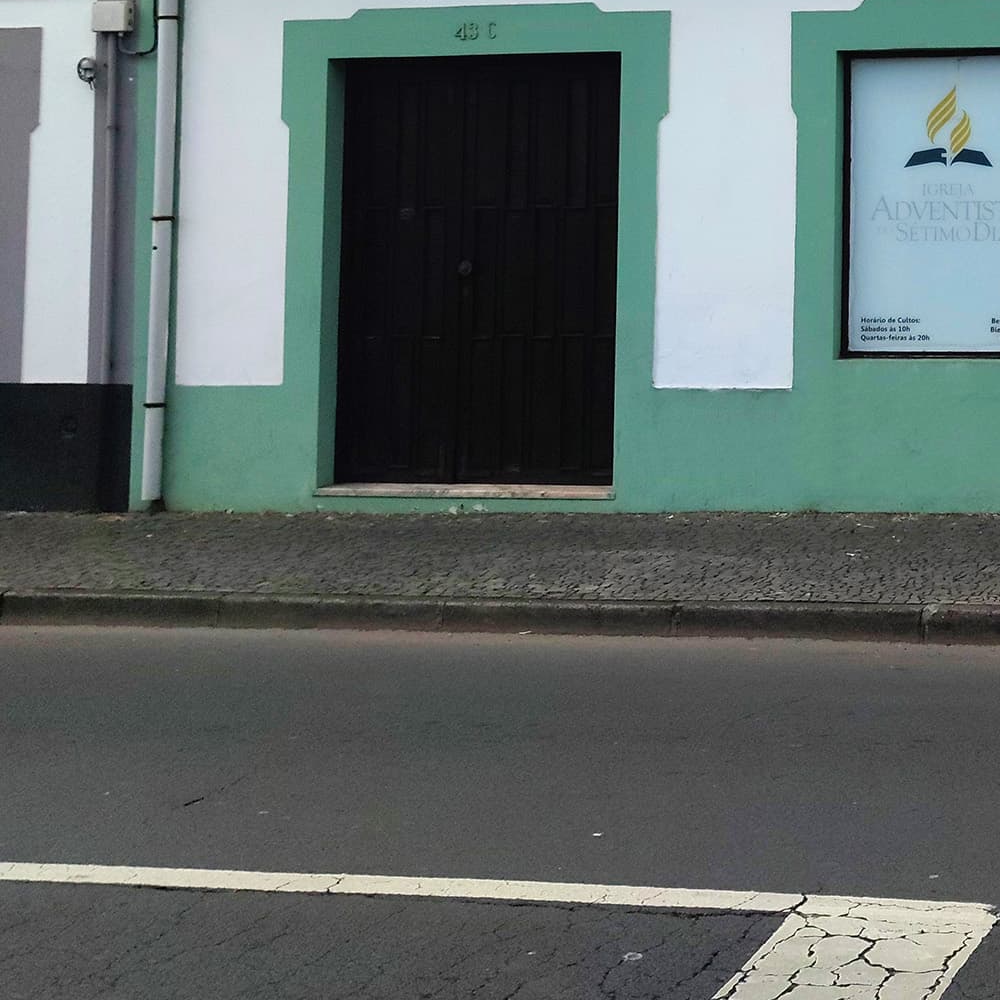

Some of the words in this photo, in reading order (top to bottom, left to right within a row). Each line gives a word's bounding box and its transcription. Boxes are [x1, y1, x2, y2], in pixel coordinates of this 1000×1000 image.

[455, 22, 480, 41] 43
[860, 325, 888, 333] Sábados
[898, 325, 911, 333] 10h
[860, 334, 907, 342] Quartas-feiras
[917, 334, 930, 342] 20h
